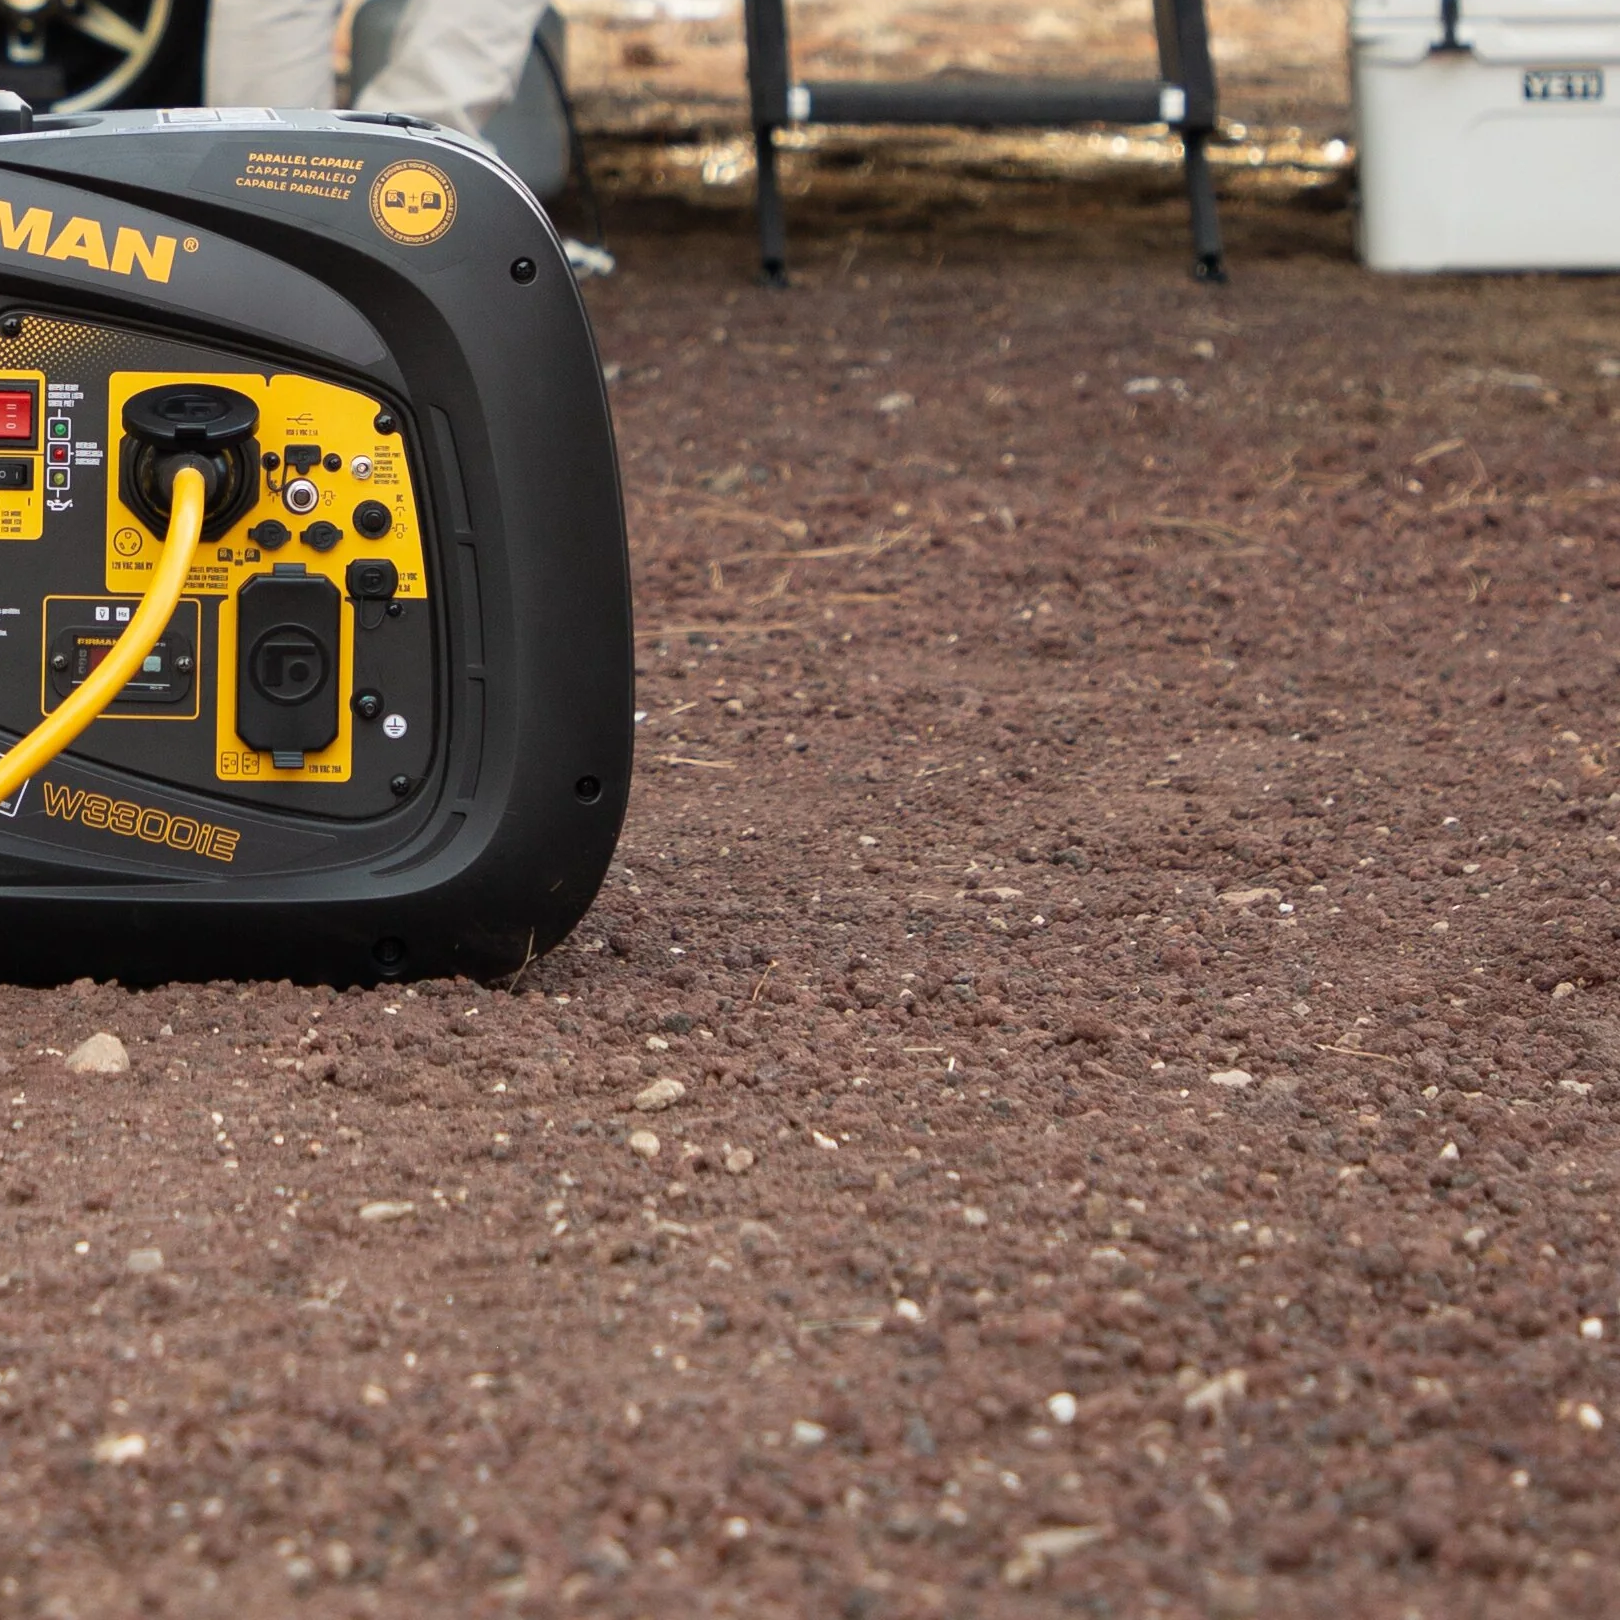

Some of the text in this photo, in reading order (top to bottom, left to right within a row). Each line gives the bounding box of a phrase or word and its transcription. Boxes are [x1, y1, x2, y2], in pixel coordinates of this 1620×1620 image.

[1526, 70, 1600, 99] YETI
[248, 153, 364, 170] PARALLEL CAPABLE
[246, 165, 357, 184] CAPAZ PARALELO
[236, 178, 351, 200] CAPABLE PARALLÈLE
[396, 494, 403, 503] DC
[123, 562, 133, 570] VAC
[309, 765, 342, 773] 120 VAC 20A
[44, 782, 240, 862] W3300iE
